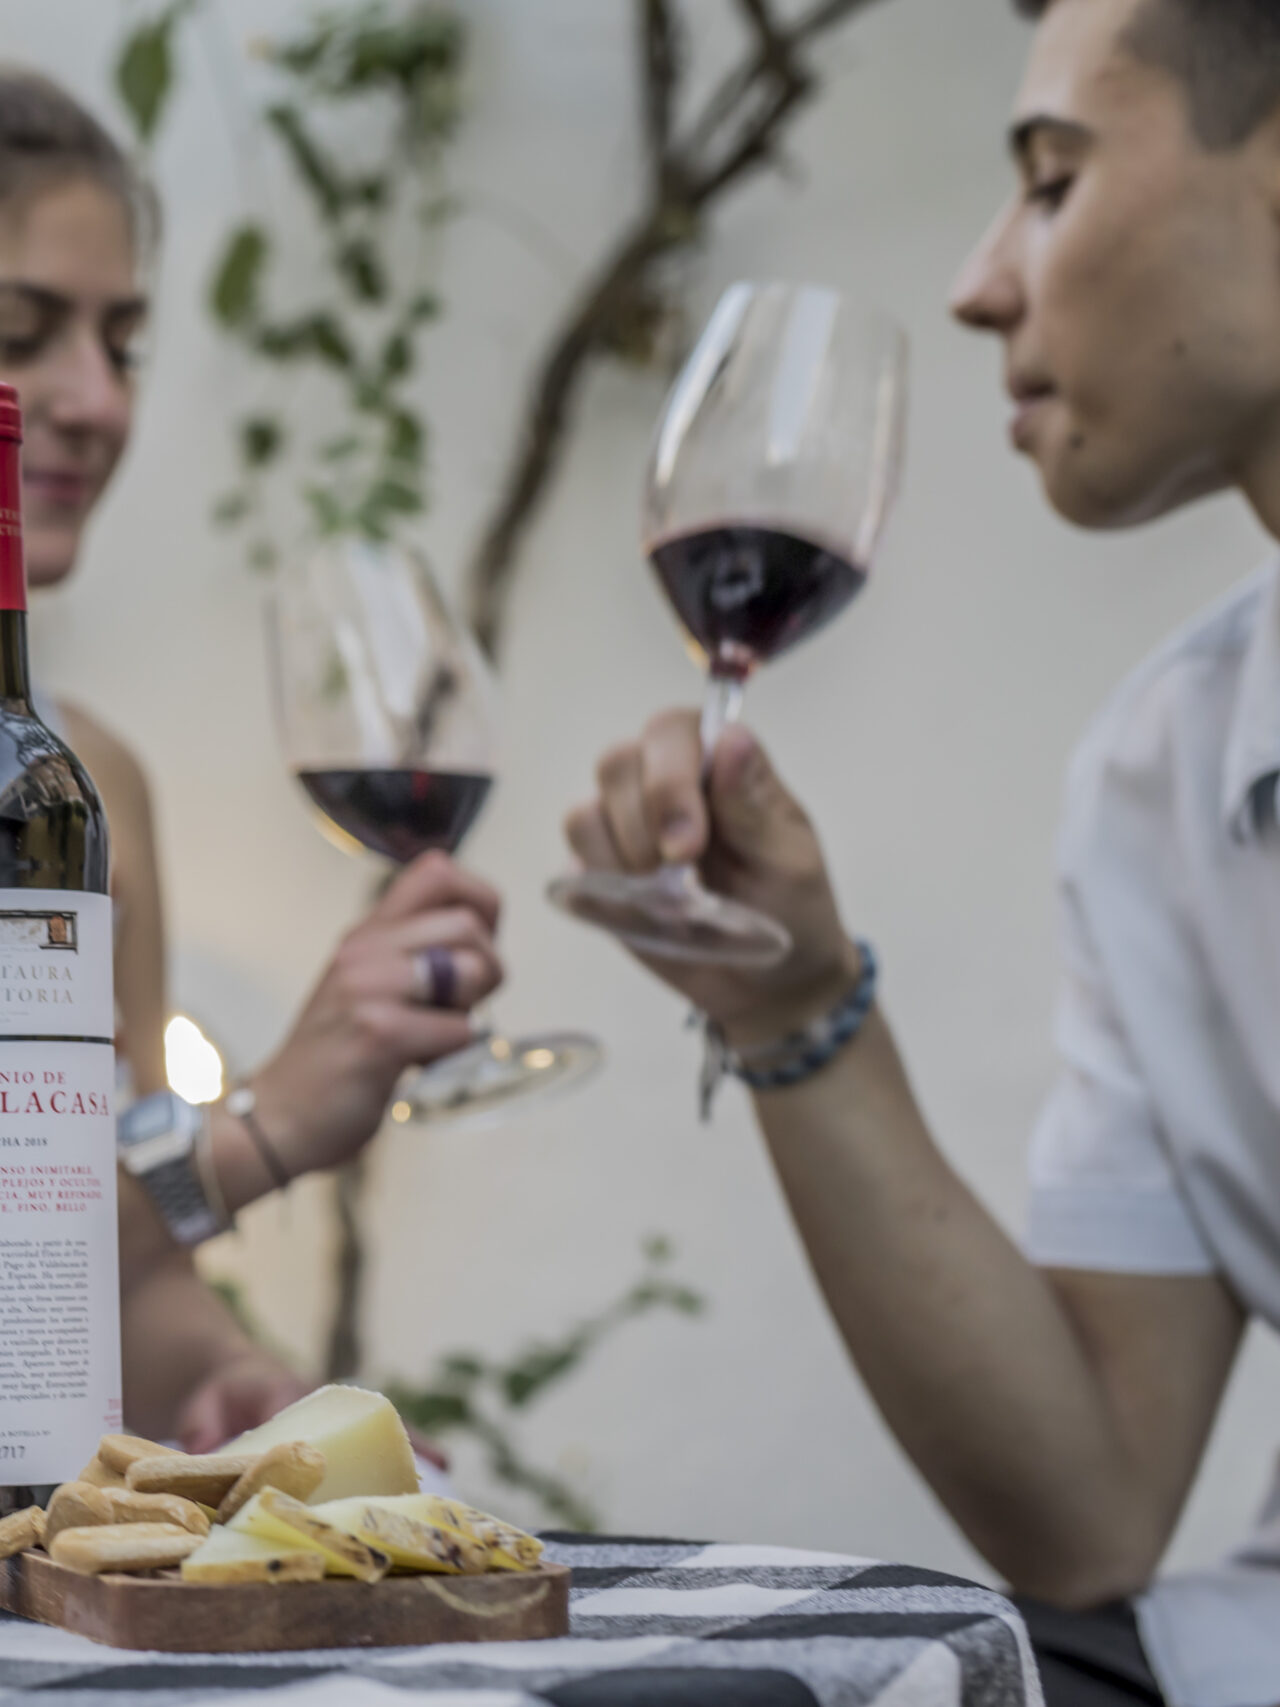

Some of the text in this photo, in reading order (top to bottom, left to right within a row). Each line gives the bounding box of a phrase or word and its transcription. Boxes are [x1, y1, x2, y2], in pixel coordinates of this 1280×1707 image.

[43, 1071, 66, 1085] DE
[49, 1178, 54, 1186] Y
[28, 1191, 52, 1199] MUY
[56, 1203, 86, 1211] BELLO
